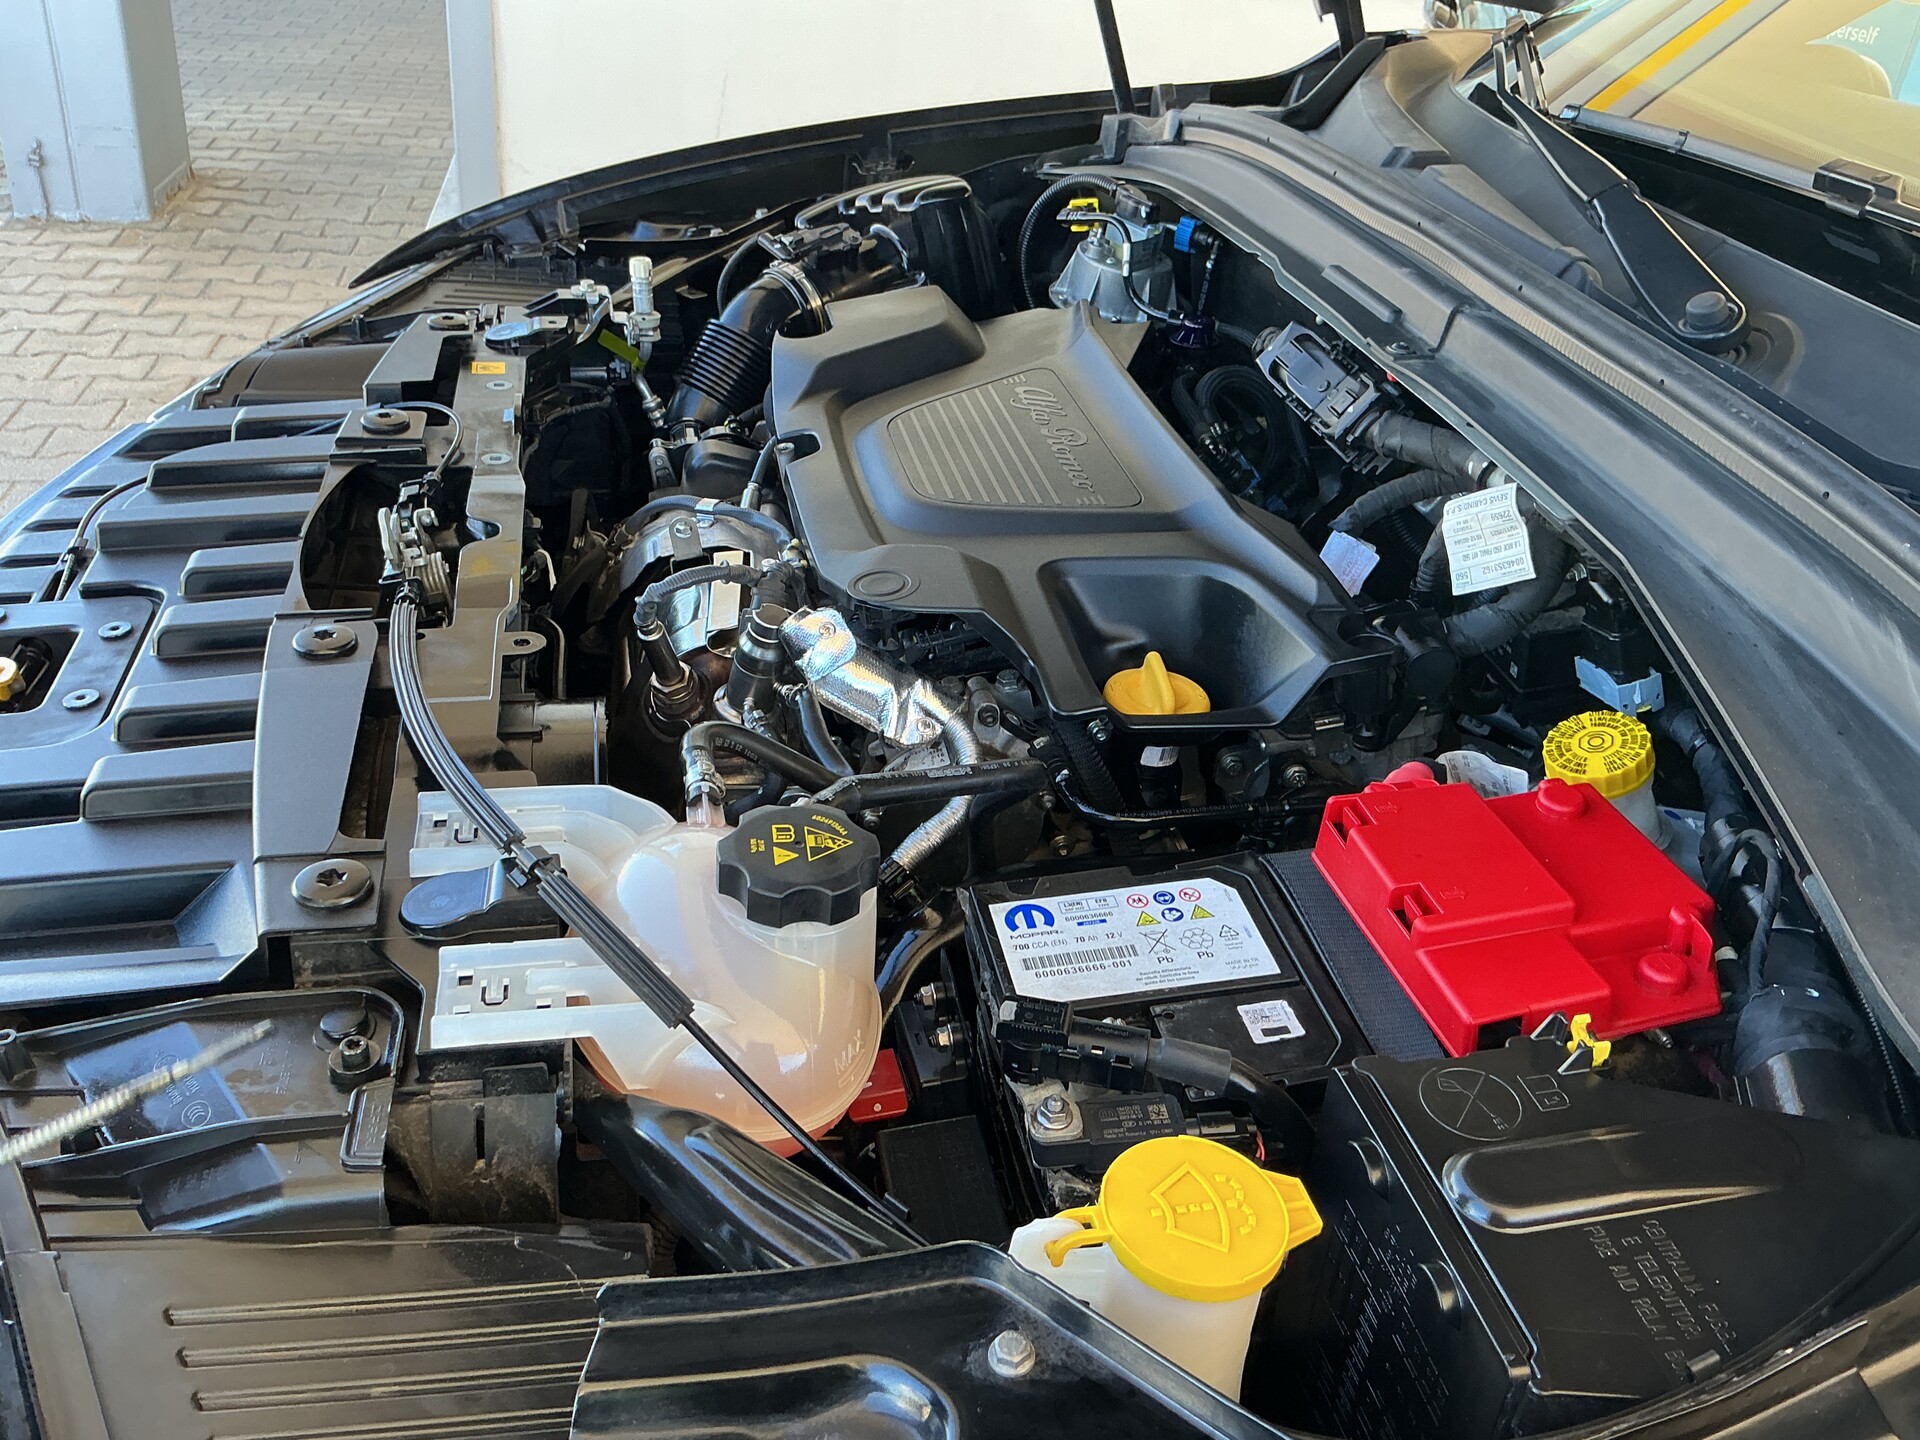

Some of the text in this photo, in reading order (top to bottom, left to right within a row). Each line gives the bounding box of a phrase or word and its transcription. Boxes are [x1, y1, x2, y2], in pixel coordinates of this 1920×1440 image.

[1010, 386, 1096, 493] Alfa Romeo
[1065, 911, 1114, 922] 6000636666
[1010, 930, 1059, 940] MOPAR
[1051, 939, 1068, 948] (EN)
[1074, 936, 1086, 944] 70
[1087, 934, 1099, 942] Ah
[1157, 955, 1174, 964] Pb
[1197, 951, 1214, 959] Pb
[1034, 959, 1134, 979] 6000636666-001
[1094, 1026, 1129, 1037] Amphenol
[834, 1028, 864, 1075] MAX
[1583, 1225, 1620, 1258] FUSE
